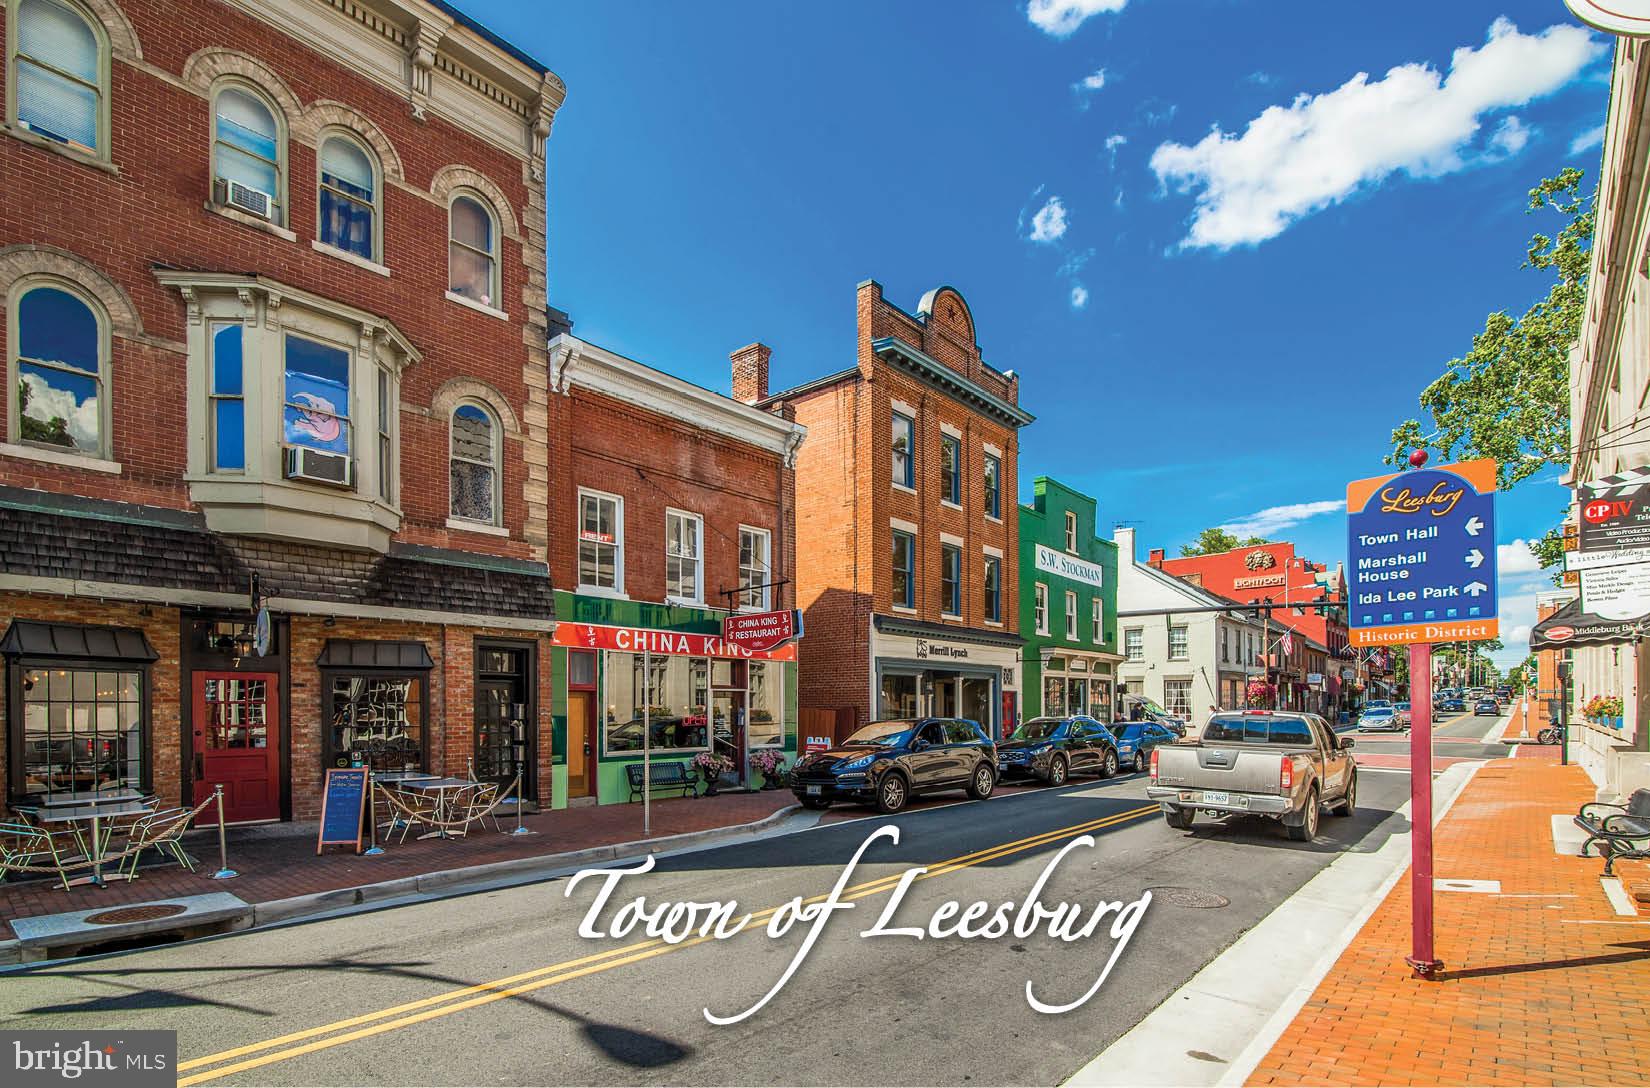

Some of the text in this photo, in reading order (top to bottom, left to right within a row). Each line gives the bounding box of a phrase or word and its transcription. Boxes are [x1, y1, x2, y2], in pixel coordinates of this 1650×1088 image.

[1380, 481, 1464, 517] Leesburg
[584, 532, 609, 542] RENT
[1358, 525, 1438, 546] Town Hall
[1040, 549, 1100, 582] S.W. STOCKMAN
[1358, 551, 1427, 570] Marshall
[1236, 577, 1285, 588] LIGHTFOOT
[1358, 569, 1409, 583] House
[1359, 585, 1459, 605] Ida Lee Park
[738, 618, 760, 629] CHINA
[760, 616, 778, 626] KING
[1574, 625, 1621, 635] Middleburg
[735, 627, 782, 640] RESTAURANT
[1359, 625, 1487, 643] Historic District
[615, 629, 690, 654] CHINA
[929, 644, 968, 659] Merrill Lynch
[232, 657, 241, 668] 7
